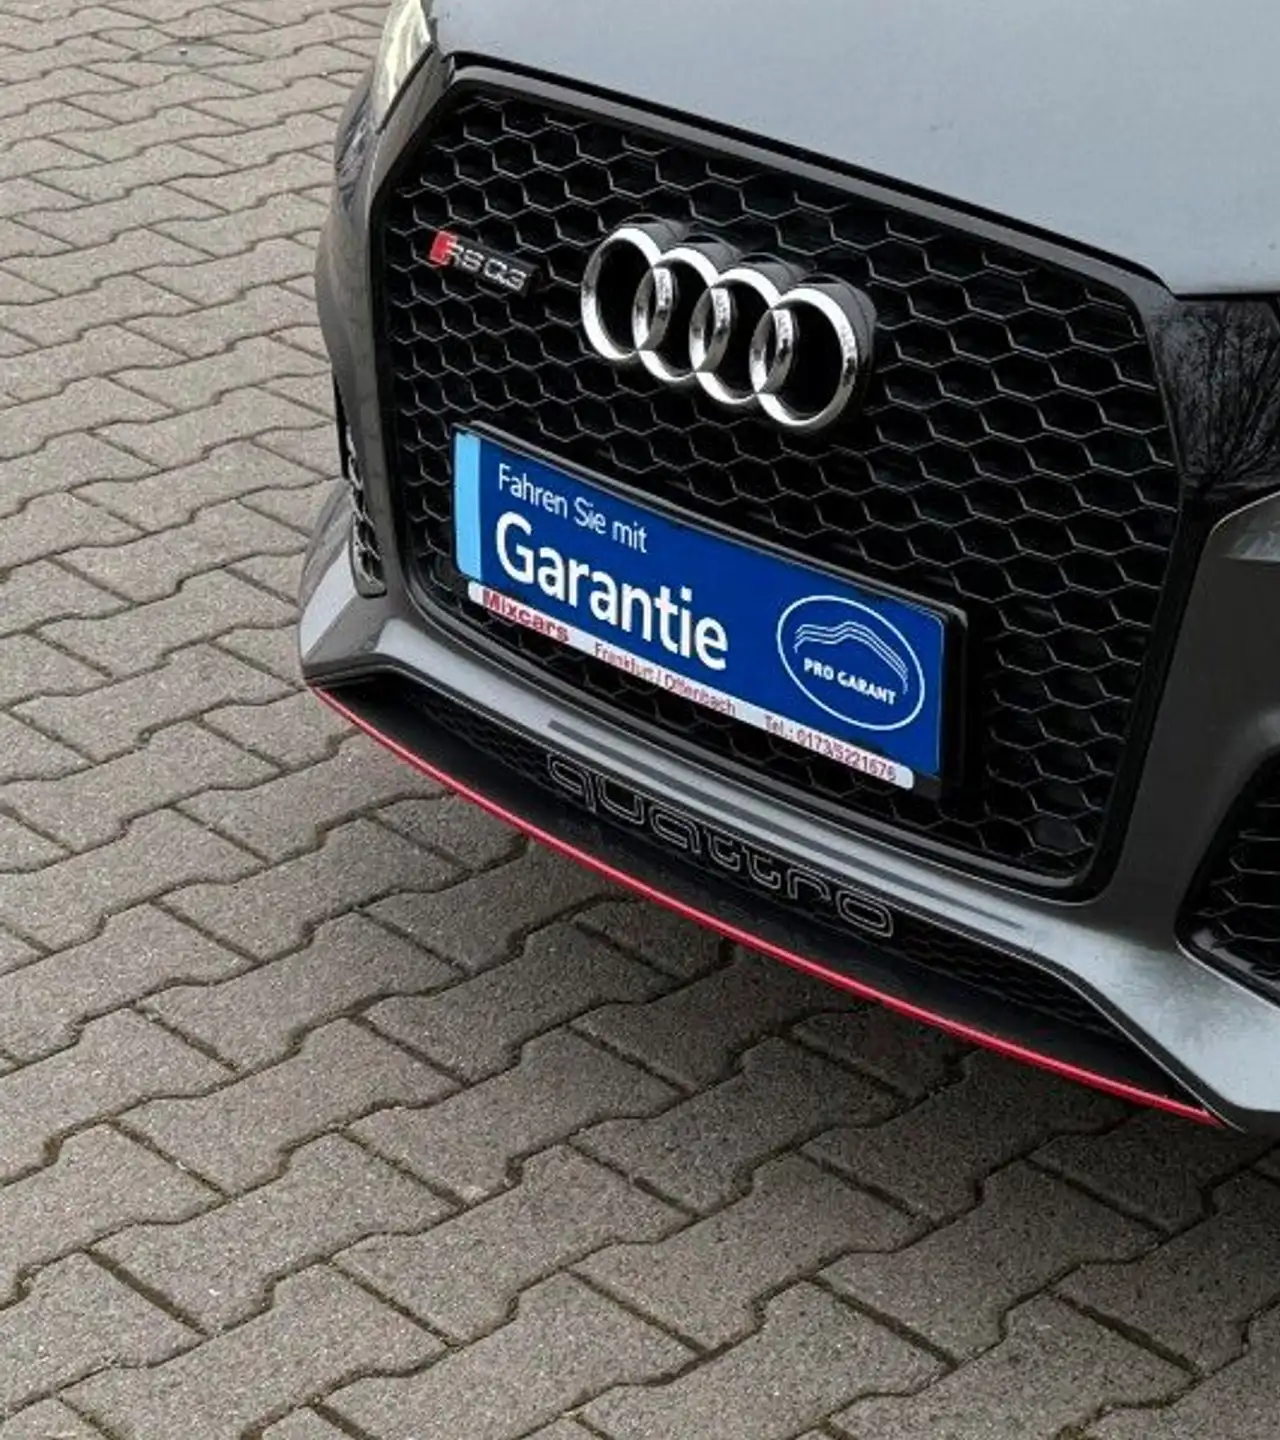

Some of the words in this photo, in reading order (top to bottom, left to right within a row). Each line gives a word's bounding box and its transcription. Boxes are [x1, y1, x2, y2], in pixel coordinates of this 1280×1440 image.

[498, 462, 568, 520] Fahren
[573, 496, 607, 535] Sie
[611, 519, 648, 554] mit
[482, 588, 570, 643] Mixcars
[496, 511, 728, 671] Garantie
[803, 657, 835, 681] PRO
[837, 669, 897, 706] GARANT
[547, 752, 894, 939] quattro
